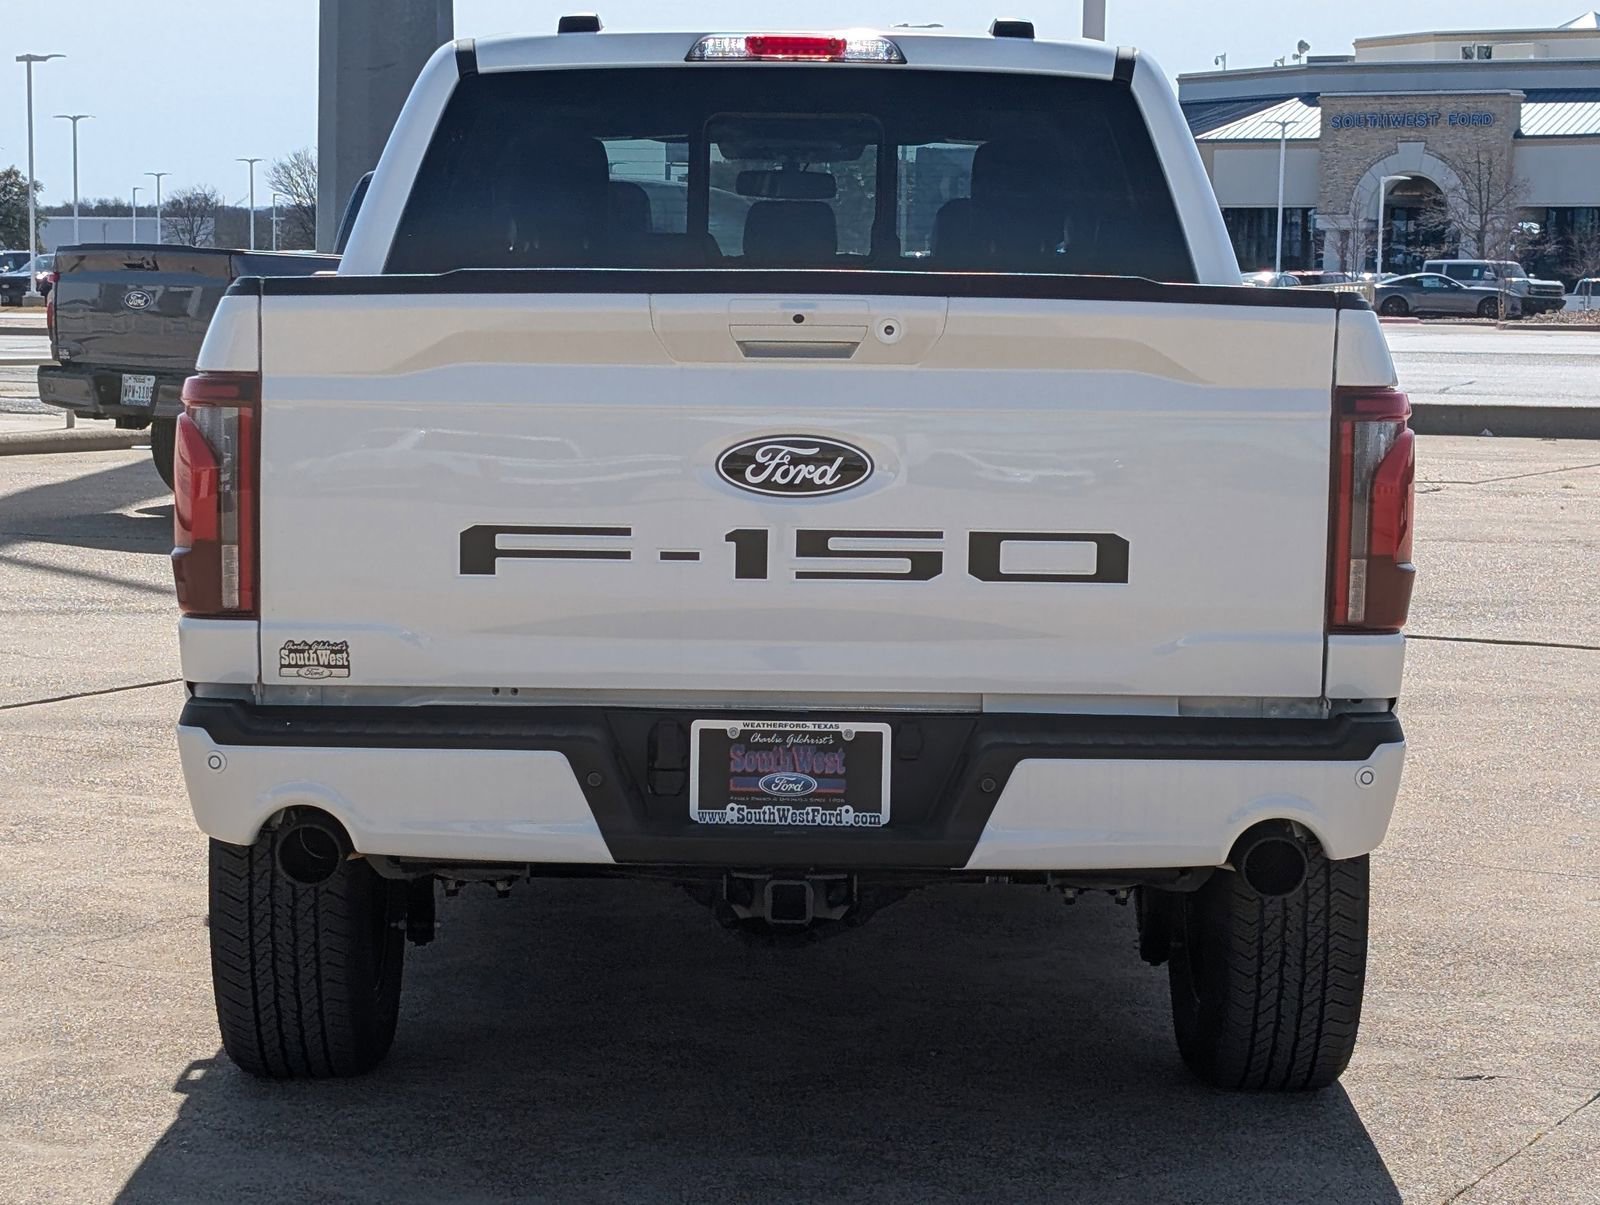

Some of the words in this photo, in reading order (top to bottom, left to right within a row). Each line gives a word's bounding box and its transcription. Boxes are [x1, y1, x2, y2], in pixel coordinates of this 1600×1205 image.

[1331, 112, 1440, 129] SOUTHWEST
[1448, 112, 1494, 127] FORD
[128, 293, 146, 306] Ford
[745, 443, 842, 486] Ford
[459, 523, 1130, 583] F-150
[280, 649, 348, 665] SouthWest
[304, 668, 325, 676] Ford
[750, 732, 783, 743] Charlie
[730, 744, 846, 774] SouthWest
[771, 776, 804, 792] Ford
